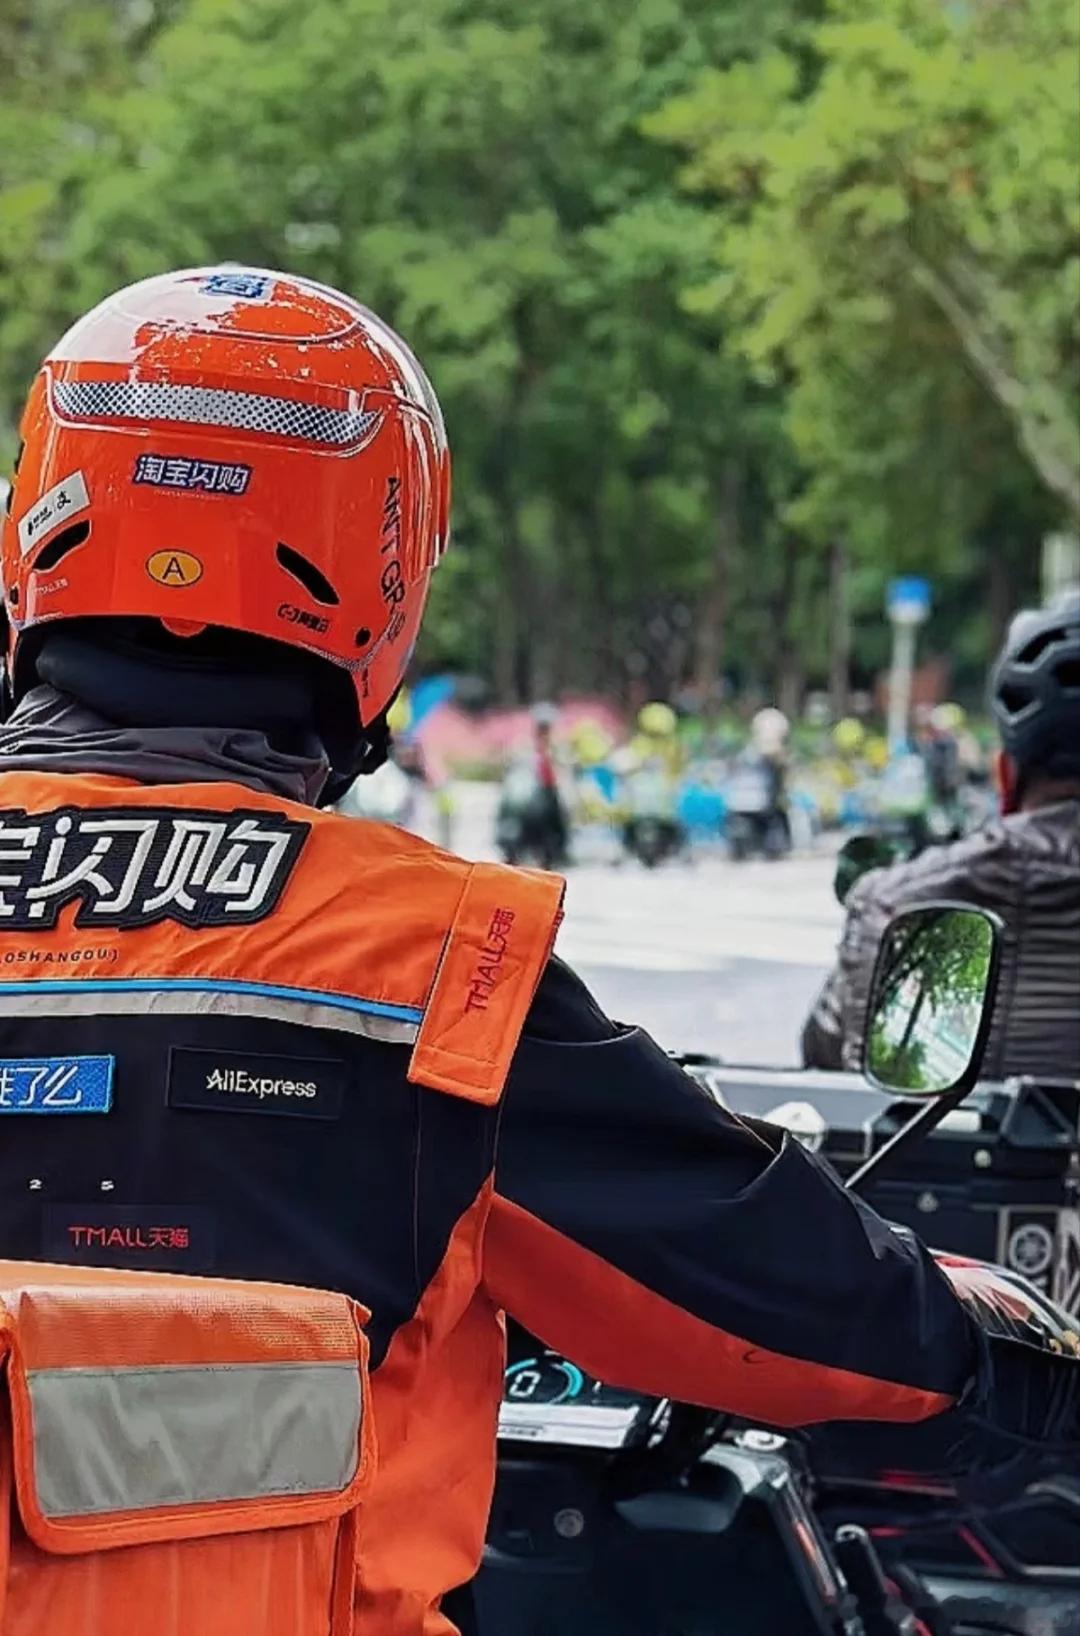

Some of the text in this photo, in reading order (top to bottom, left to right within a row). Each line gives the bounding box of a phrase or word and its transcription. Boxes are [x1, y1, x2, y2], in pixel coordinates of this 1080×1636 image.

[136, 456, 249, 492] 淘宝闪购
[162, 556, 187, 582] A
[0, 948, 118, 964] OSHANGOU)
[206, 1068, 318, 1099] AliExpress
